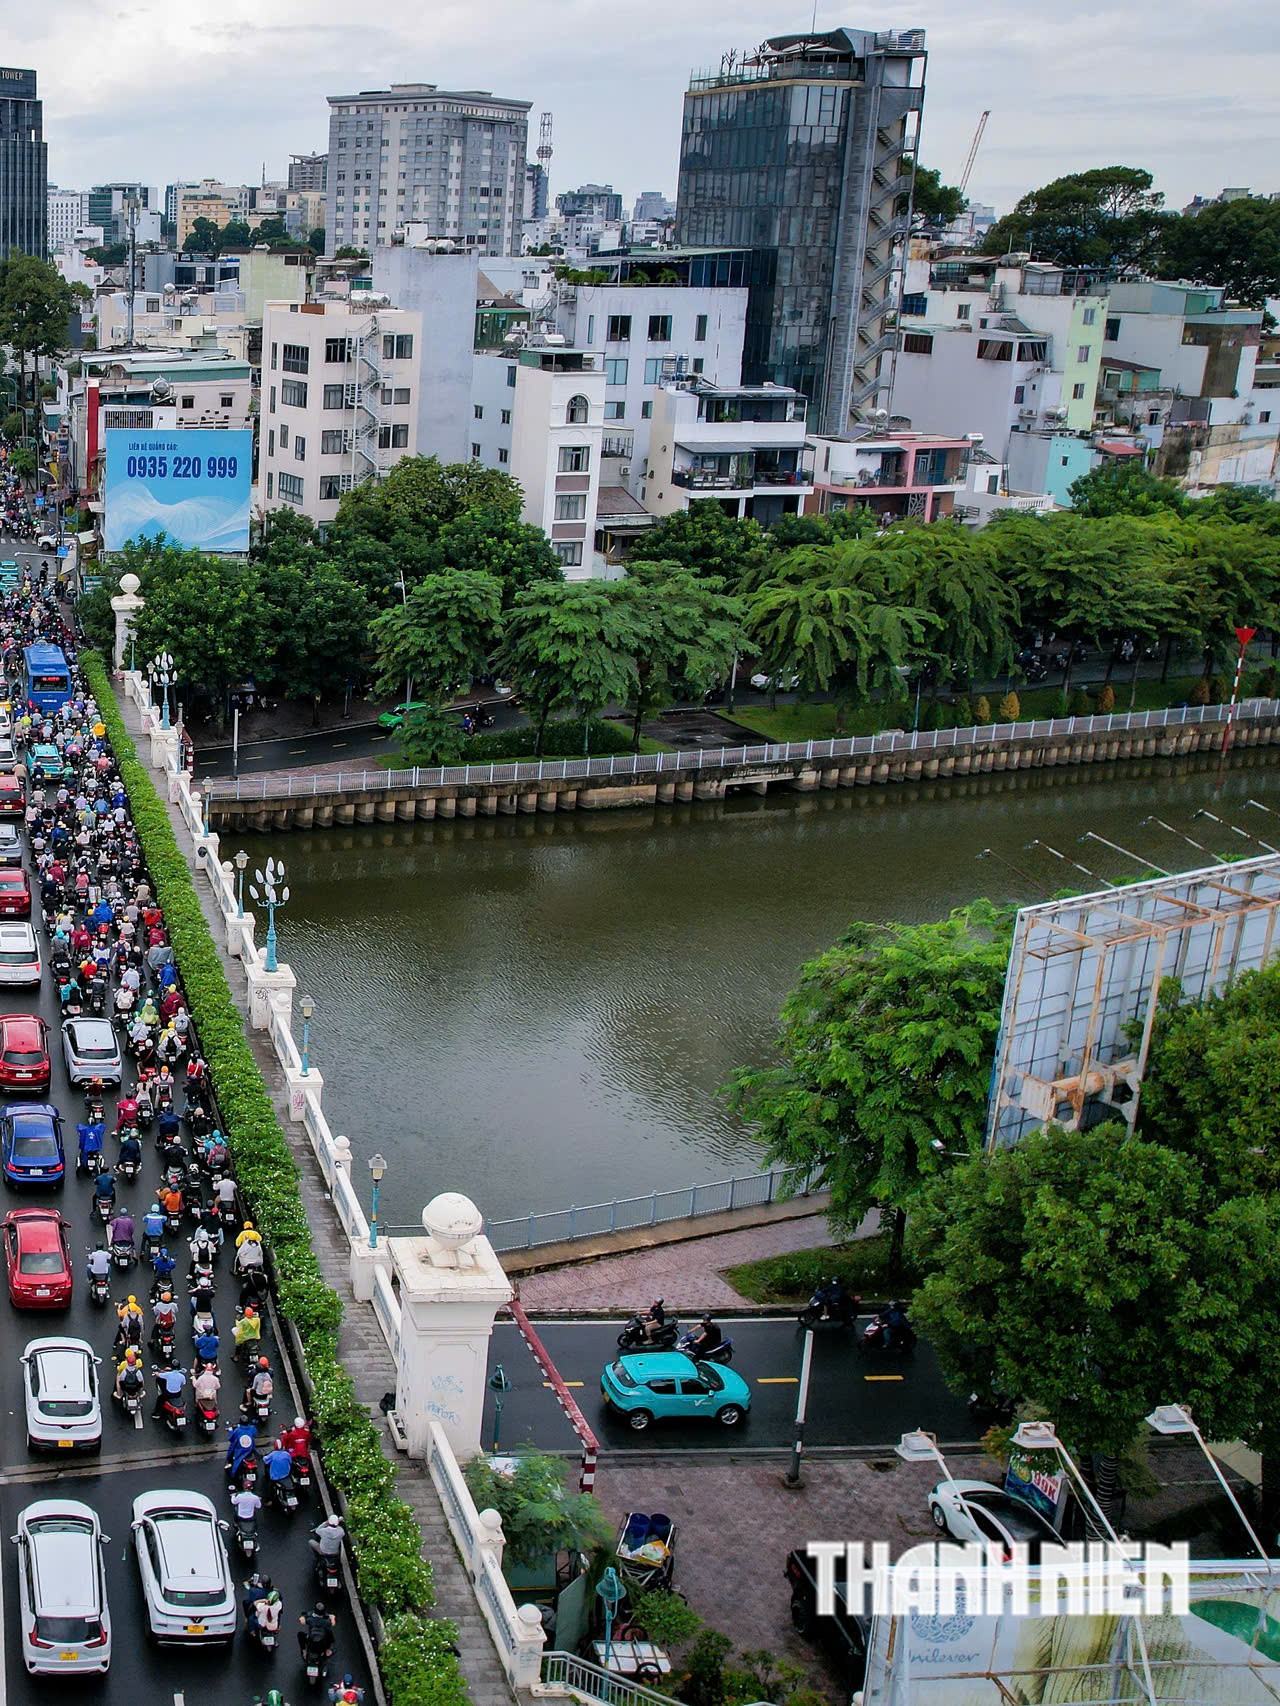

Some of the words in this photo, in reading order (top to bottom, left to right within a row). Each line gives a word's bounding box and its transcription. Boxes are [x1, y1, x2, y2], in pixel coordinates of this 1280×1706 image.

[1, 71, 24, 81] TOWER
[127, 456, 167, 478] 0935
[173, 457, 201, 478] 220
[207, 457, 238, 478] 999
[908, 1648, 981, 1664] nilever
